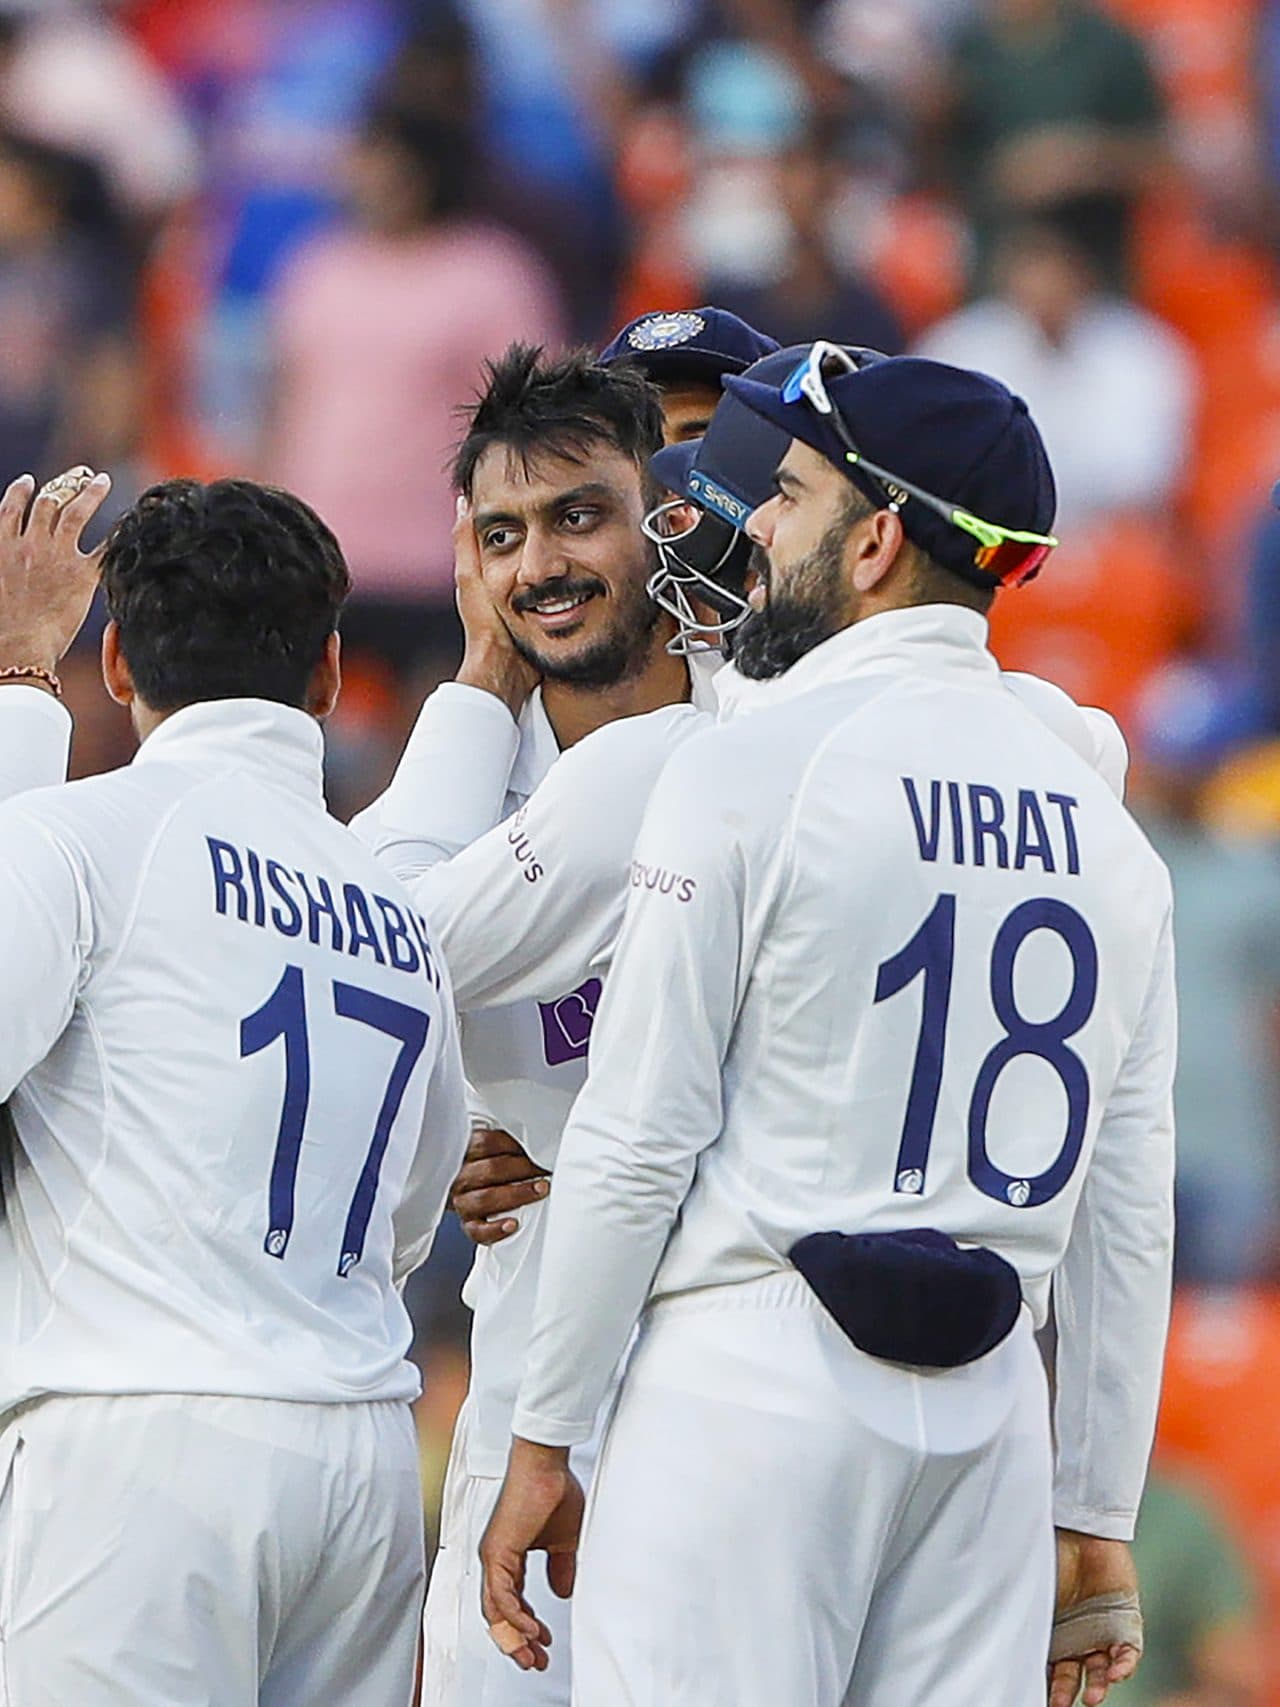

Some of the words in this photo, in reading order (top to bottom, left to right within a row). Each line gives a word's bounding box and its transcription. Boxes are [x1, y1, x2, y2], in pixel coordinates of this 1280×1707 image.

[704, 484, 746, 519] SHREY
[900, 775, 1081, 876] VIRAT
[206, 835, 441, 993] RISHABH
[240, 964, 431, 1278] 17
[873, 893, 1099, 1208] 18
